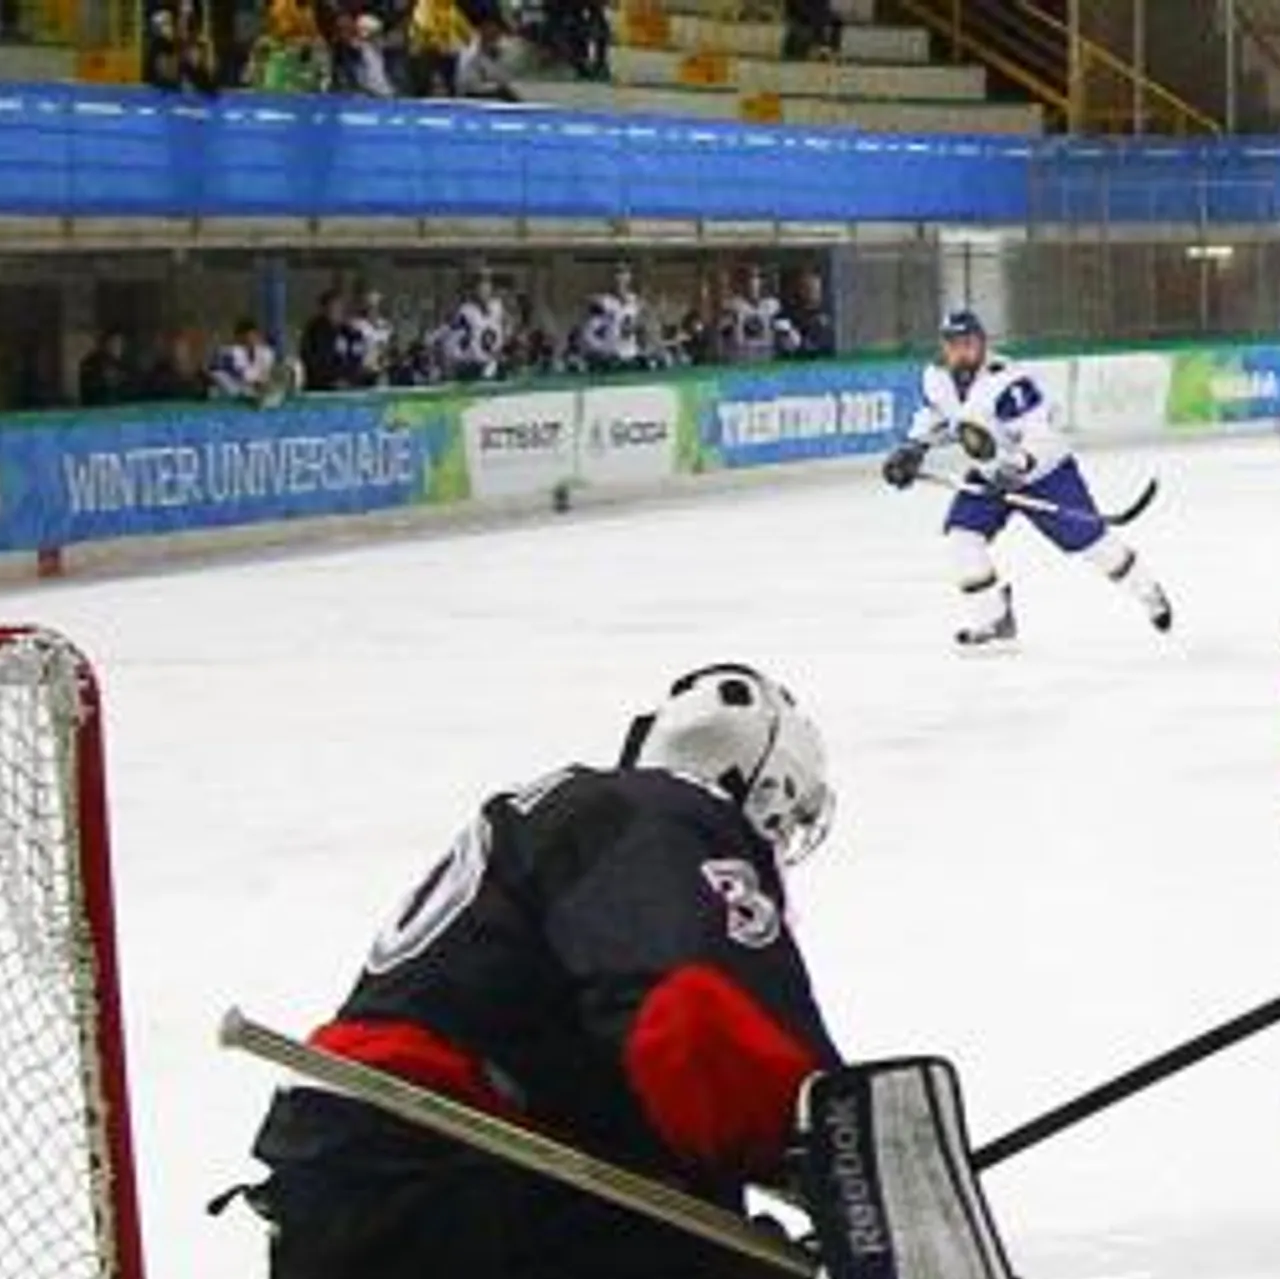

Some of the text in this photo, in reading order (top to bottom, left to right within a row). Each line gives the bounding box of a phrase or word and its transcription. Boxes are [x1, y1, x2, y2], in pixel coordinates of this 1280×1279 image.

[63, 428, 416, 513] WINTER UNIVERSIADE
[699, 857, 780, 947] 3
